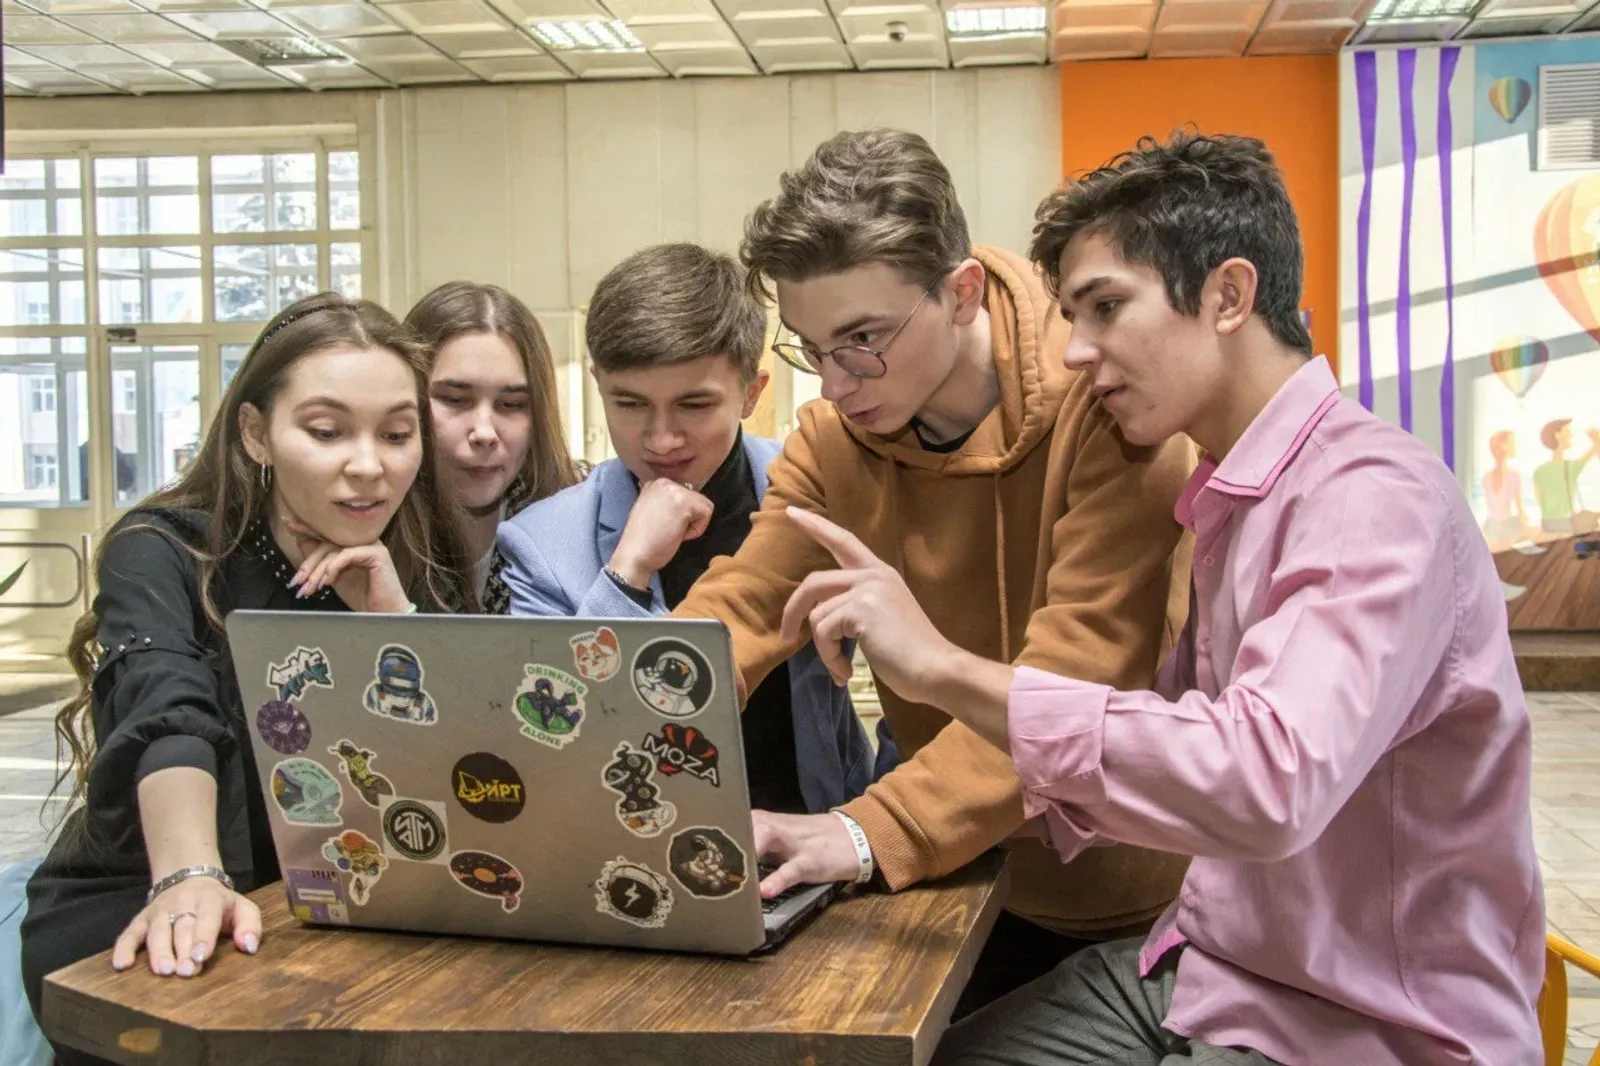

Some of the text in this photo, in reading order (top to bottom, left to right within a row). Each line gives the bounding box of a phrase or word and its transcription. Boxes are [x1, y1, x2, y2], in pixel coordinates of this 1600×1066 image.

[526, 666, 585, 695] DRINKING
[523, 726, 561, 747] ALONE
[643, 735, 718, 785] MOZA
